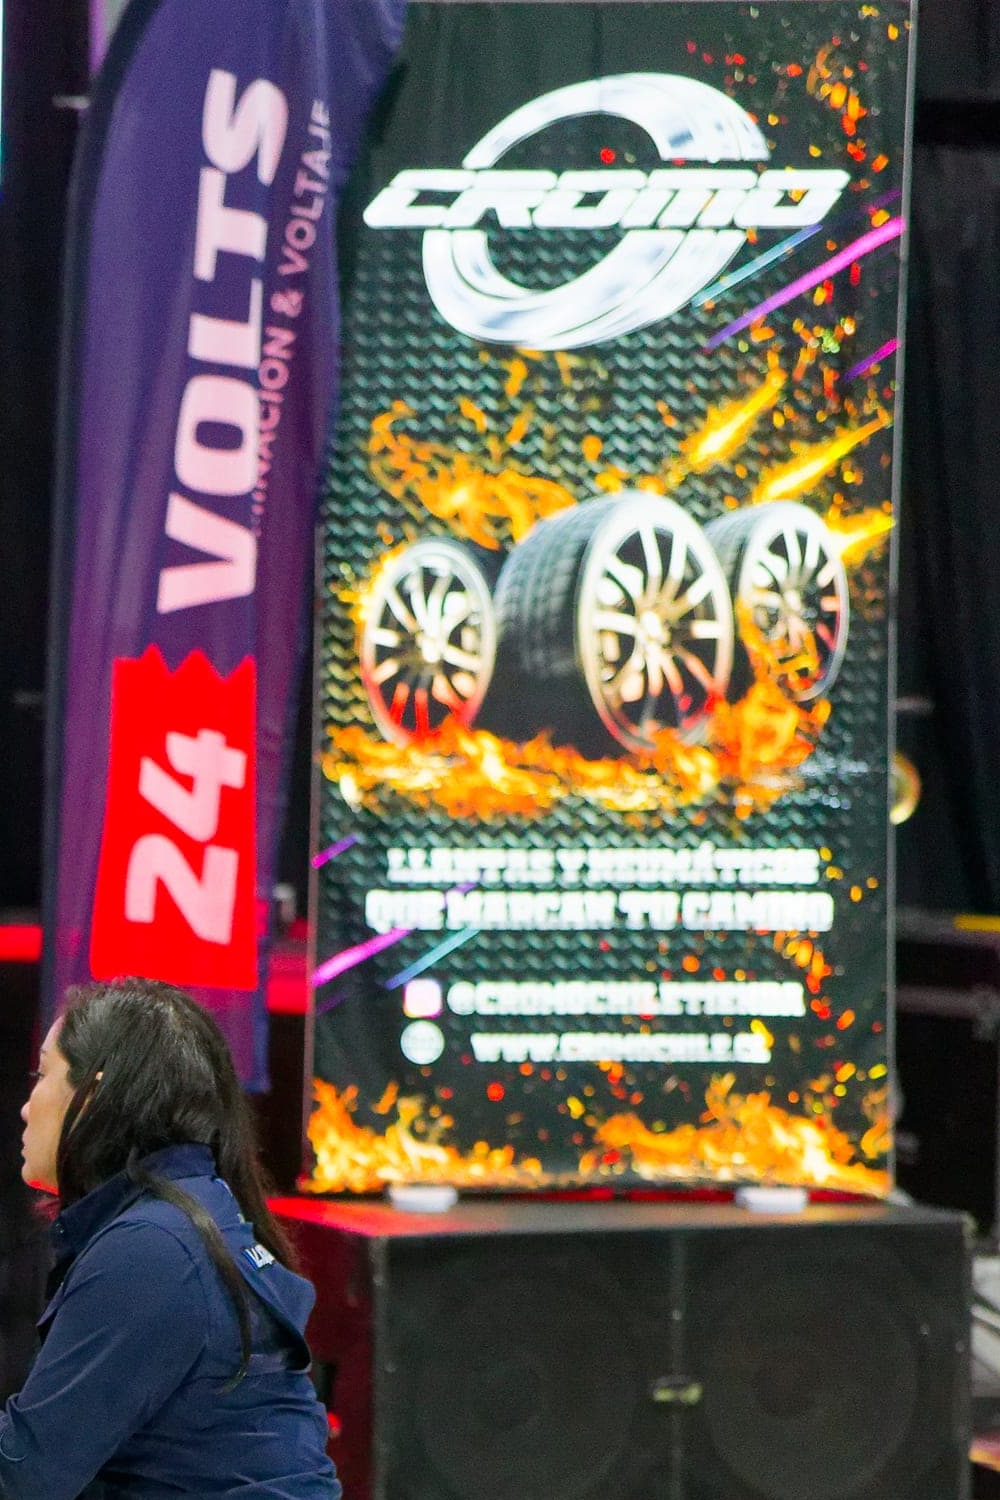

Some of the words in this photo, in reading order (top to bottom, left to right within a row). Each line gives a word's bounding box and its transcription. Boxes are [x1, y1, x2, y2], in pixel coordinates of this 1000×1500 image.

[362, 168, 852, 229] CROMO
[270, 288, 305, 318] &
[157, 69, 288, 614] VOLTS
[124, 728, 247, 945] 24
[556, 849, 587, 883] Y
[365, 890, 446, 933] QUE
[447, 890, 617, 931] MARCAN
[619, 890, 681, 931] TU
[682, 889, 835, 932] CAMINO
